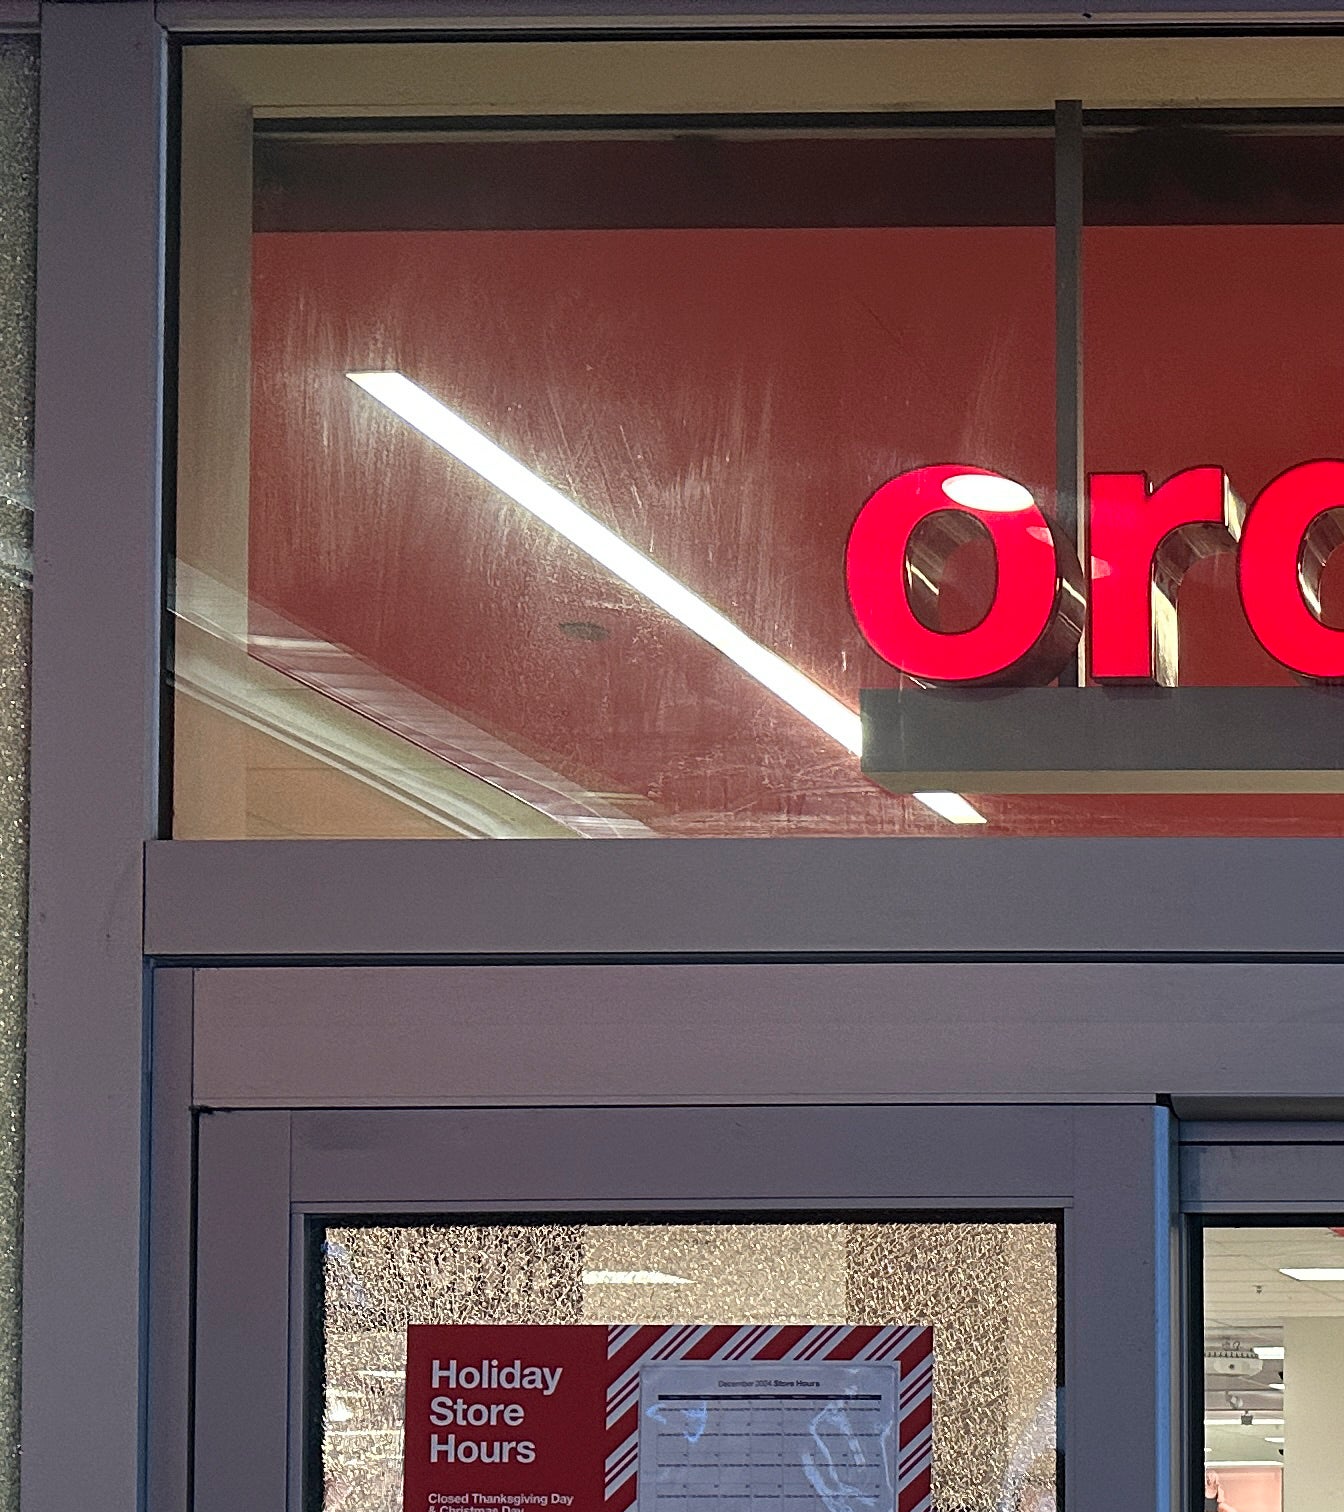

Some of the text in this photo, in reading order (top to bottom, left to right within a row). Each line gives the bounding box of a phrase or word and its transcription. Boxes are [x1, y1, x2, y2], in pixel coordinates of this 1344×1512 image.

[431, 1359, 563, 1396] Holiday
[430, 1396, 524, 1426] Store
[430, 1433, 536, 1463] Hours
[428, 1493, 574, 1506] Closed Thanksgiving Day
